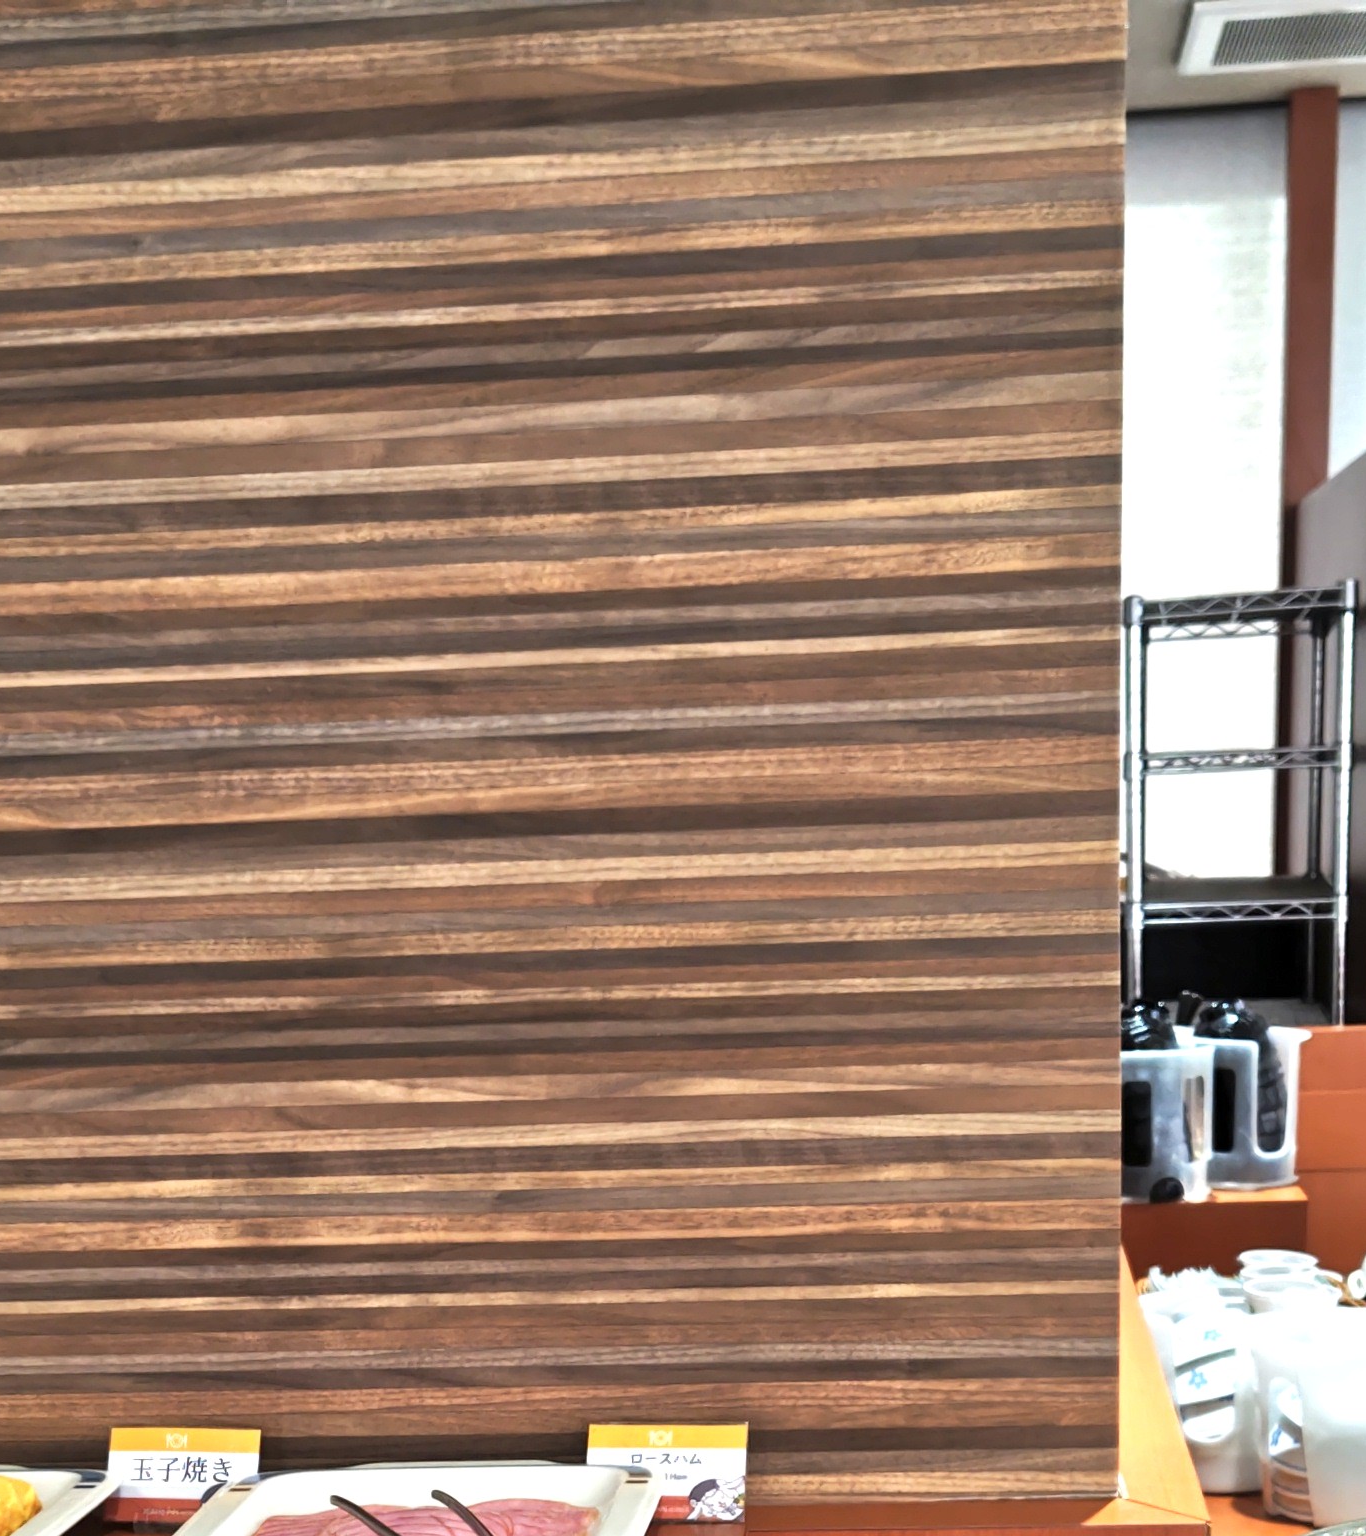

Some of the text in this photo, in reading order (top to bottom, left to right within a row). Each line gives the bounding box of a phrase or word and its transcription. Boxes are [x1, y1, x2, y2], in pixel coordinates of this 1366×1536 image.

[131, 1456, 233, 1483] 玉子焼き
[631, 1453, 703, 1466] ロースハム
